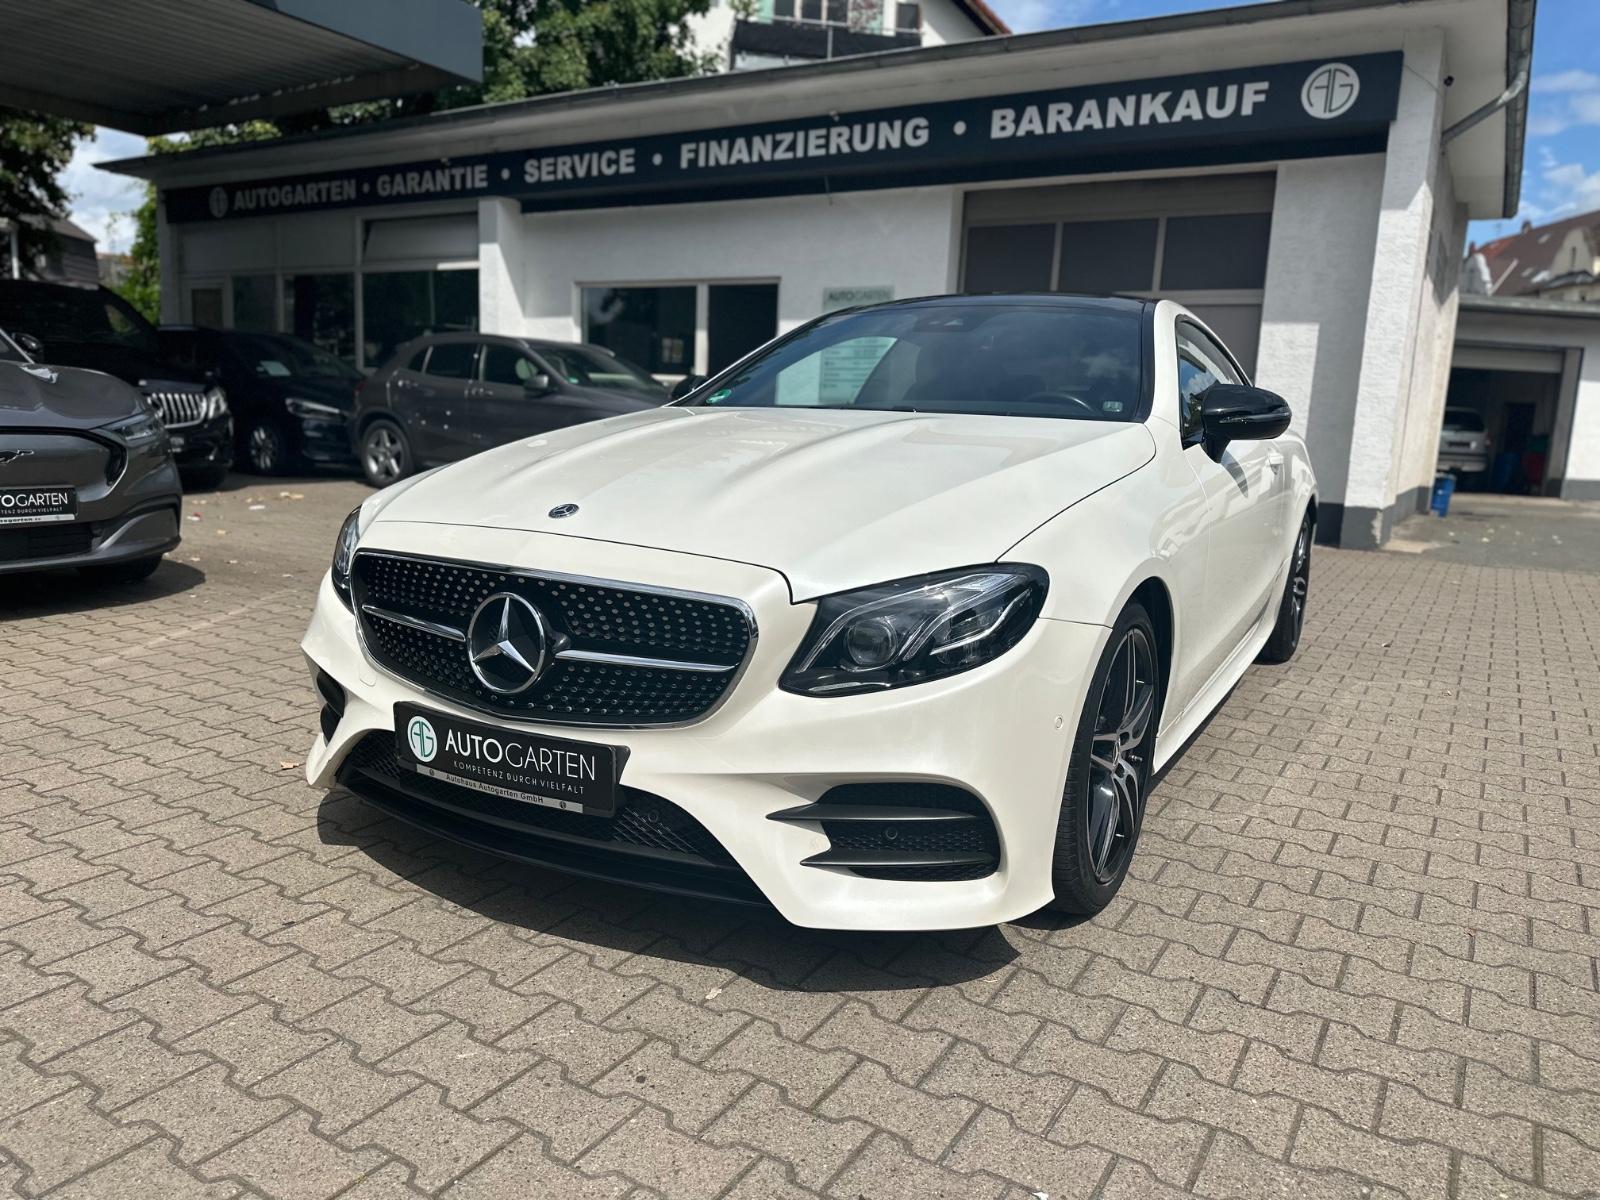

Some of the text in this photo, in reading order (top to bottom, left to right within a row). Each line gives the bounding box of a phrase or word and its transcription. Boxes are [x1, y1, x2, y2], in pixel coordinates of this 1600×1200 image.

[233, 179, 356, 211] AUTOGARTEN
[376, 164, 489, 197] GARANTIE
[523, 148, 636, 184] SERVICE
[679, 117, 930, 169] FINANZIERUNG
[990, 81, 1269, 139] BARANKAUF
[0, 492, 68, 507] OGARTEN
[445, 729, 595, 781] AUTOGARTEN
[446, 773, 544, 805] Autohaus Autogarten GmbH
[453, 760, 585, 795] KOMPETENZ DURCH VIELFALT
